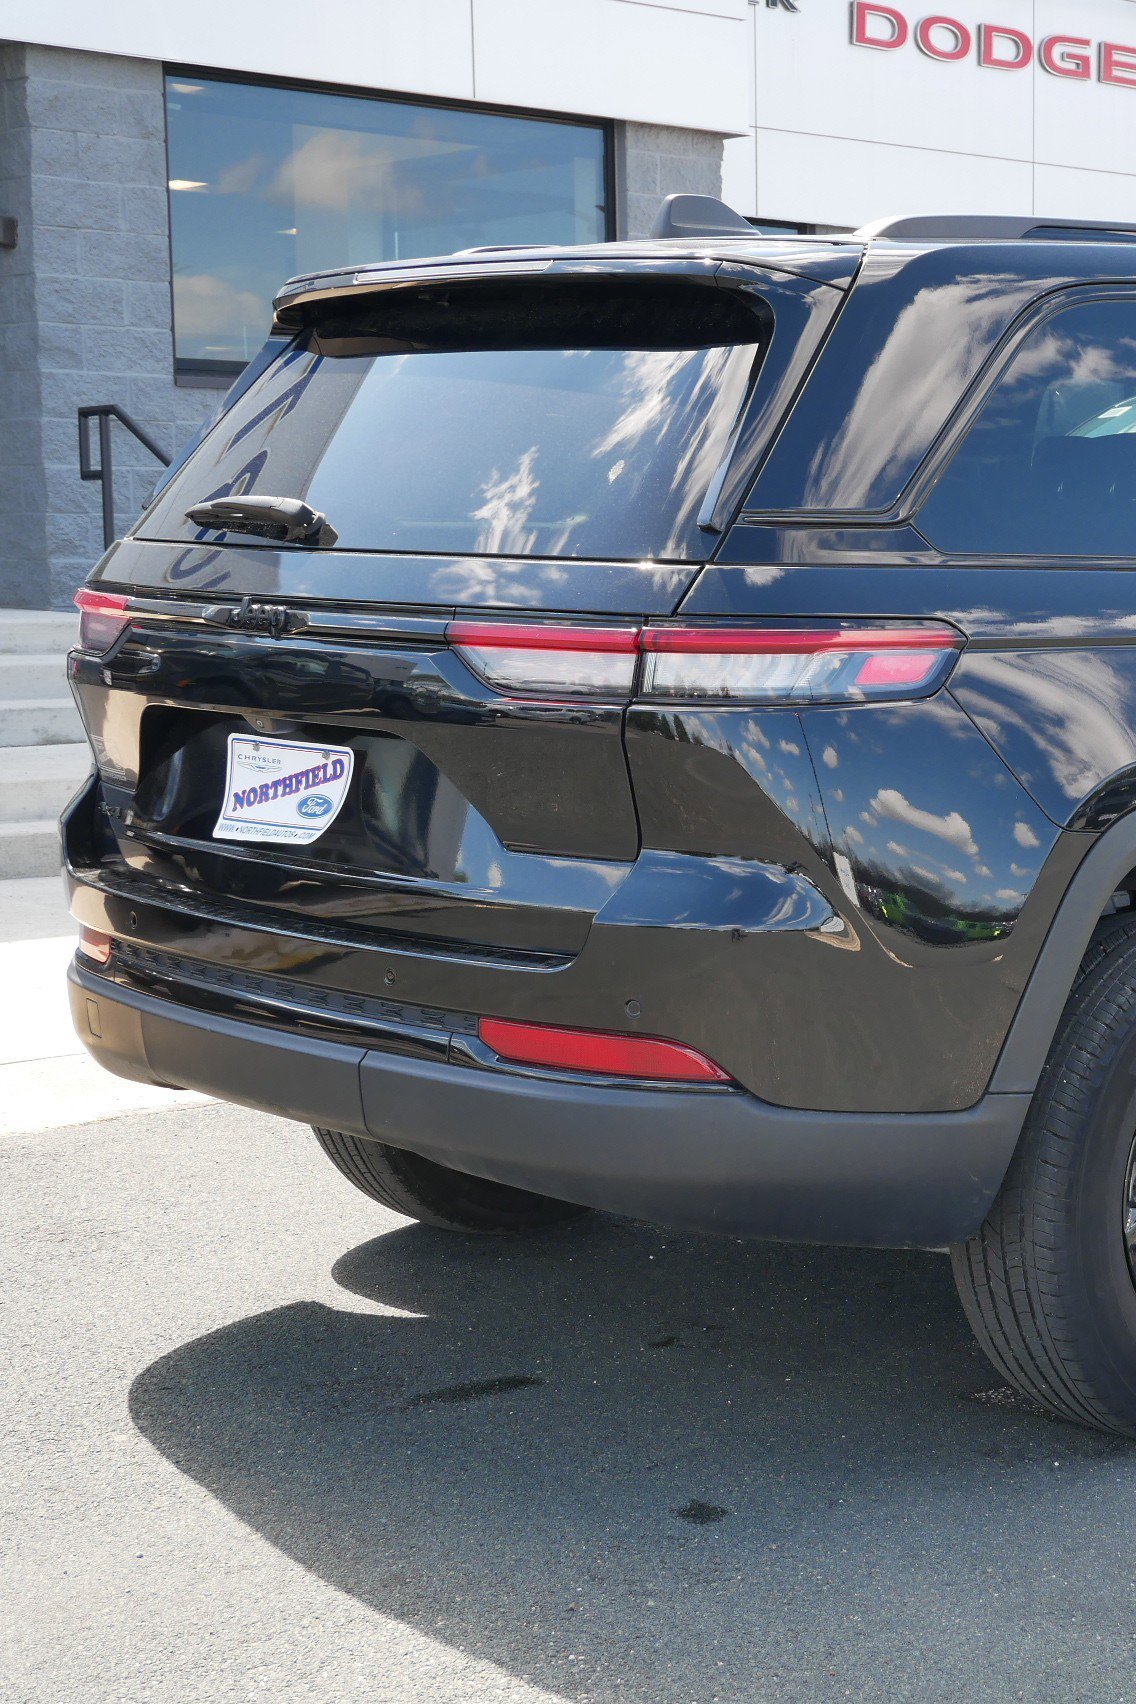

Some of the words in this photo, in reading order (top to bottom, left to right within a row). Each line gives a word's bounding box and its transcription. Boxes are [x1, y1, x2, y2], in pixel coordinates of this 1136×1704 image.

[229, 597, 286, 638] Jeep
[237, 754, 282, 766] CHRYSLER
[232, 758, 345, 812] NORTHFIELD
[301, 797, 328, 815] Ford
